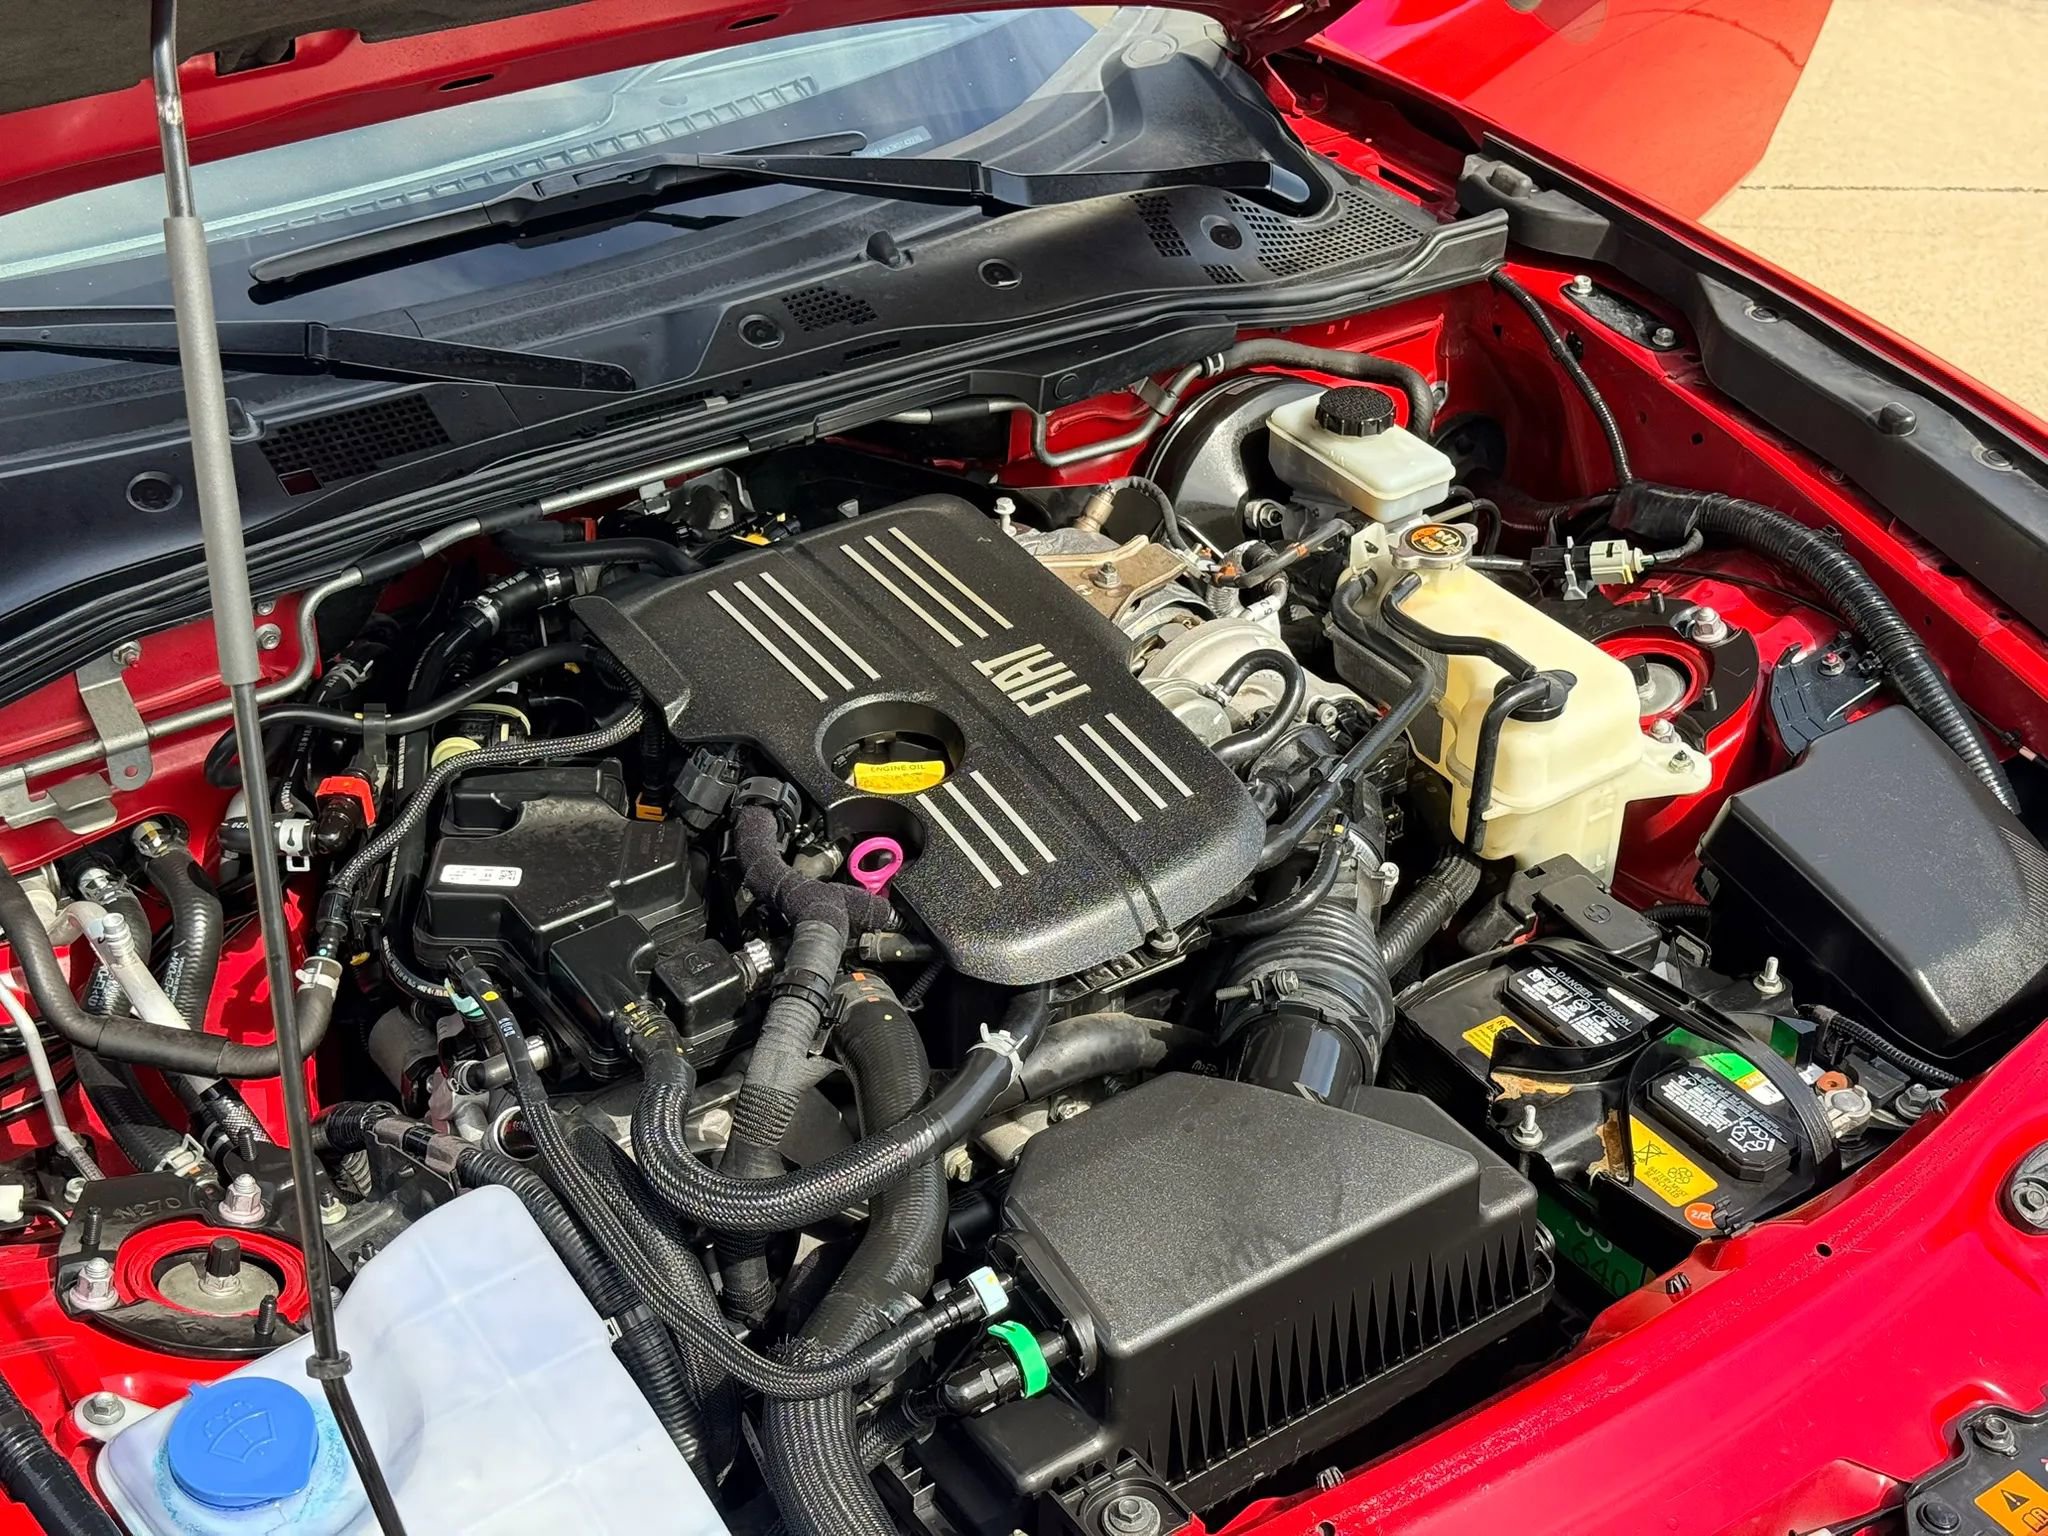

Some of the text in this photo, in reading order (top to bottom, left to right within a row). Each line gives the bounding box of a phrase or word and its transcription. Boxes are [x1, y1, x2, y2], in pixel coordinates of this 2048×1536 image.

[970, 643, 1092, 717] FIAT
[870, 765, 907, 773] ENGINE
[1556, 970, 1594, 998] DANGER
[1597, 1000, 1633, 1026] POISON
